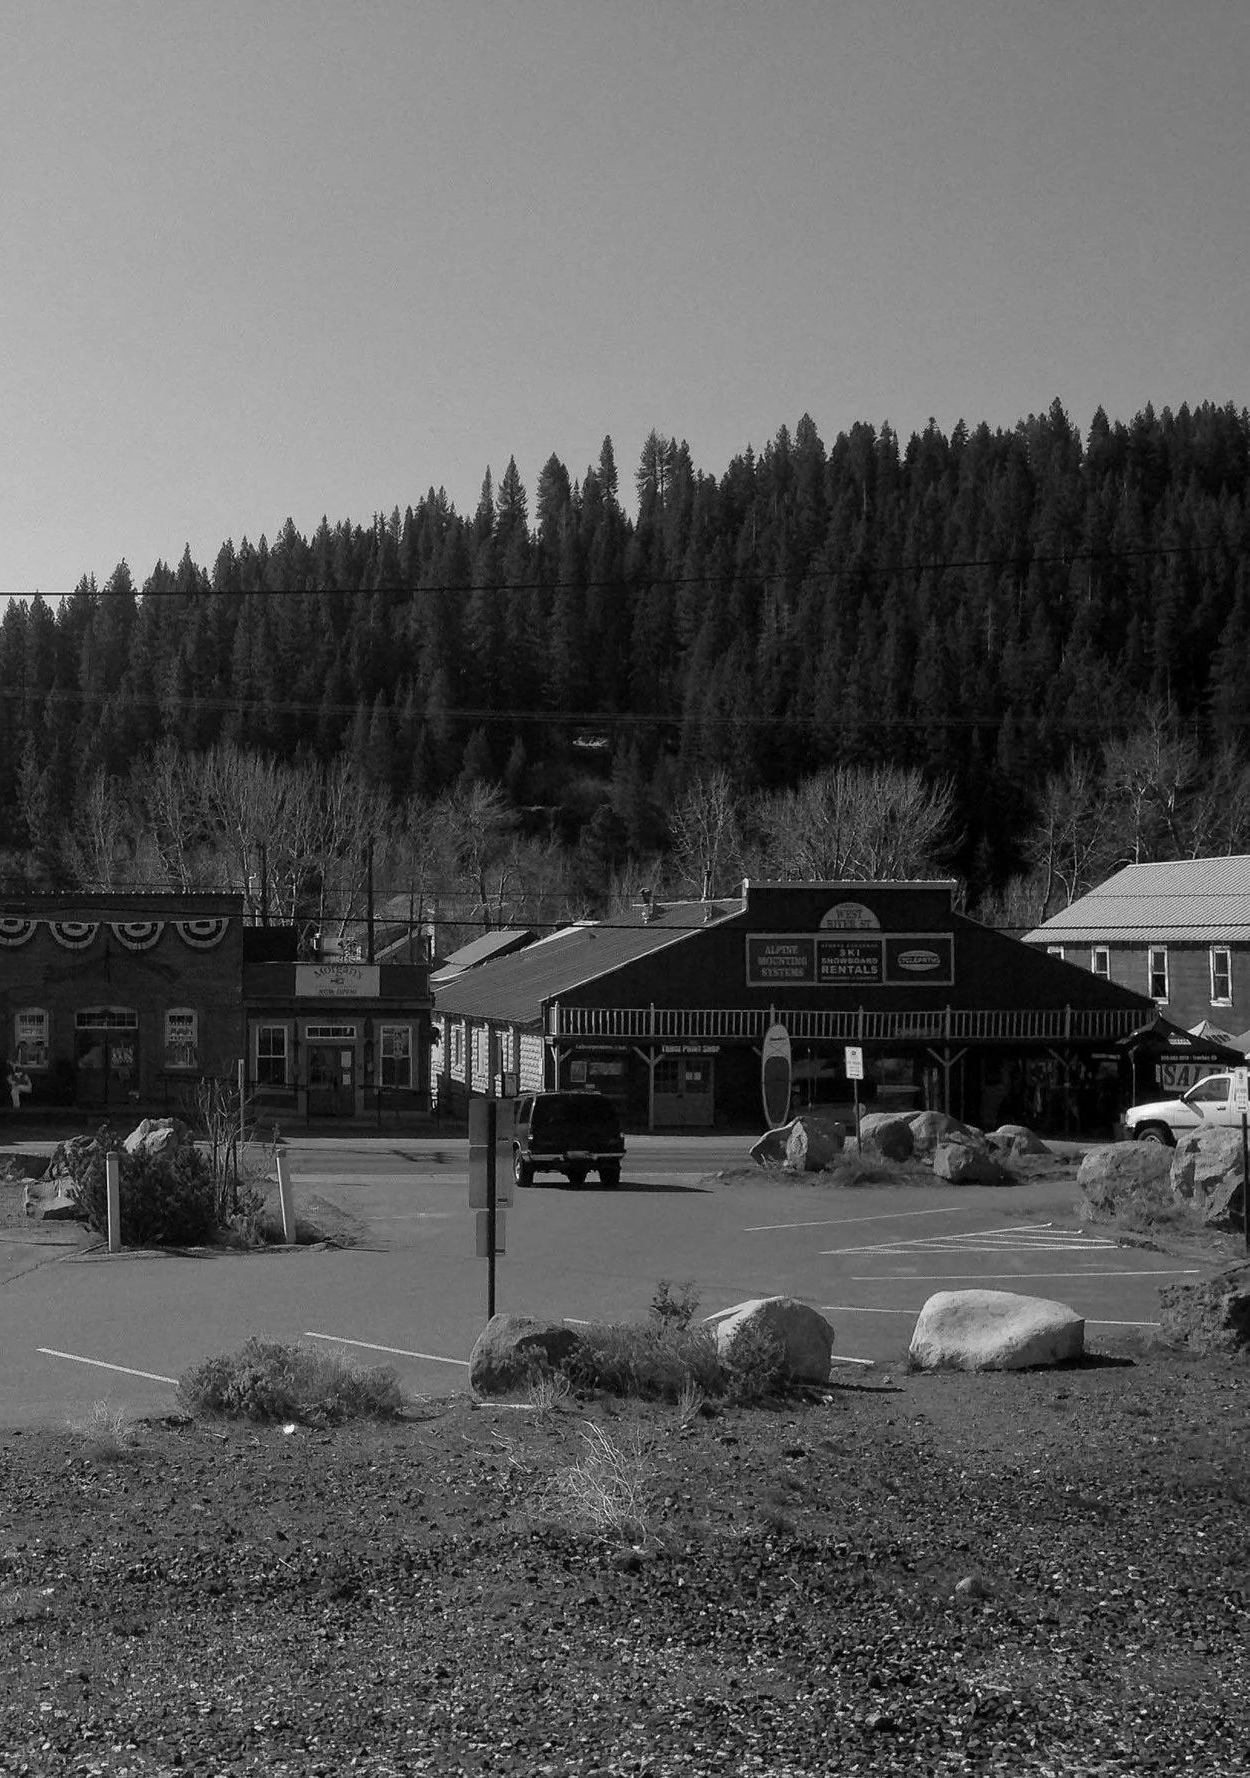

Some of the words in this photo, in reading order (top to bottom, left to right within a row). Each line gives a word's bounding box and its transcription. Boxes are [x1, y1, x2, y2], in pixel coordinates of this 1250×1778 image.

[836, 909, 862, 919] WEST
[826, 919, 857, 928] RIVER
[764, 945, 798, 955] ALPINE
[839, 948, 860, 957] SKI
[757, 956, 808, 966] MOUNTING
[821, 957, 878, 965] SNOWBOARD
[761, 967, 804, 977] SYSTEMS
[821, 965, 879, 975] RENTALS
